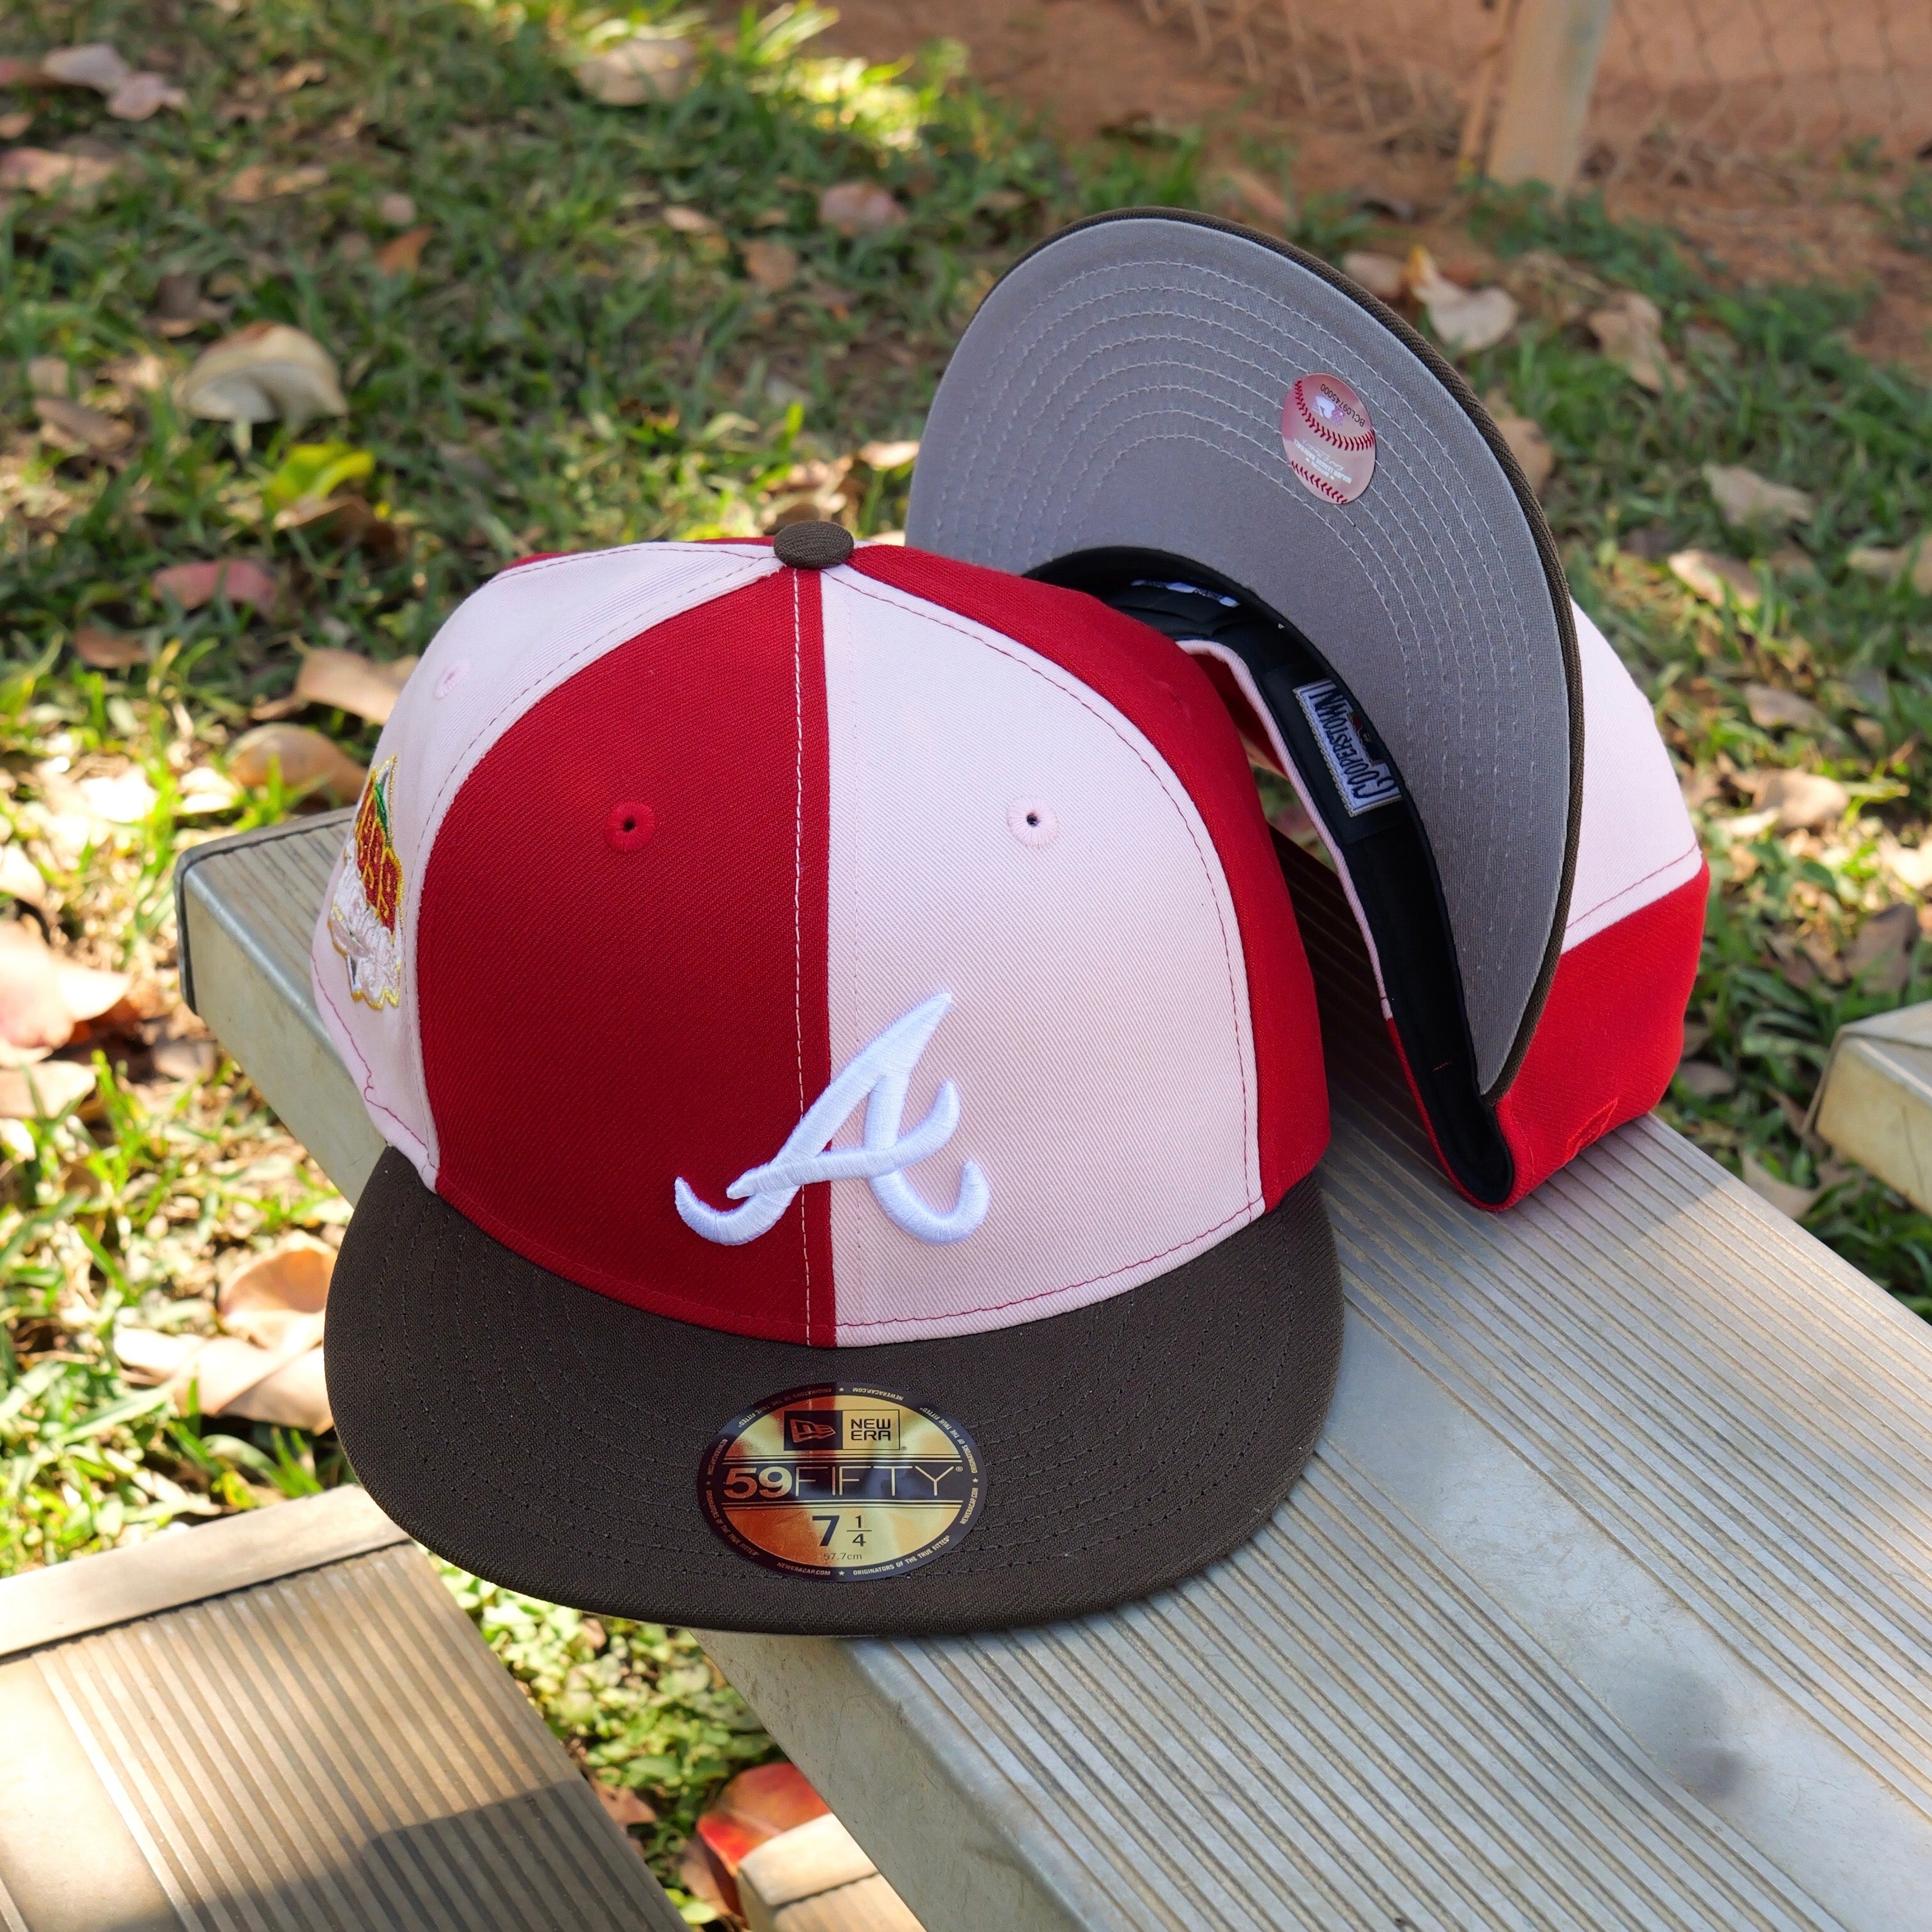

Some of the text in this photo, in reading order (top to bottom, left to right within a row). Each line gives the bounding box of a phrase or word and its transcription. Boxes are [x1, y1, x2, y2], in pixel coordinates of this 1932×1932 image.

[1320, 383, 1365, 427] BCL09745000
[1309, 688, 1398, 799] COOPERSTOWN
[852, 1387, 904, 1401] NEWERACAP.COM
[851, 1418, 891, 1430] NEW
[851, 1430, 891, 1441] ERA
[777, 1561, 830, 1575] NEWERACAP.COM
[853, 1564, 895, 1575] ORIGINATORS
[905, 1556, 918, 1564] THE
[917, 1548, 934, 1559] TRUE
